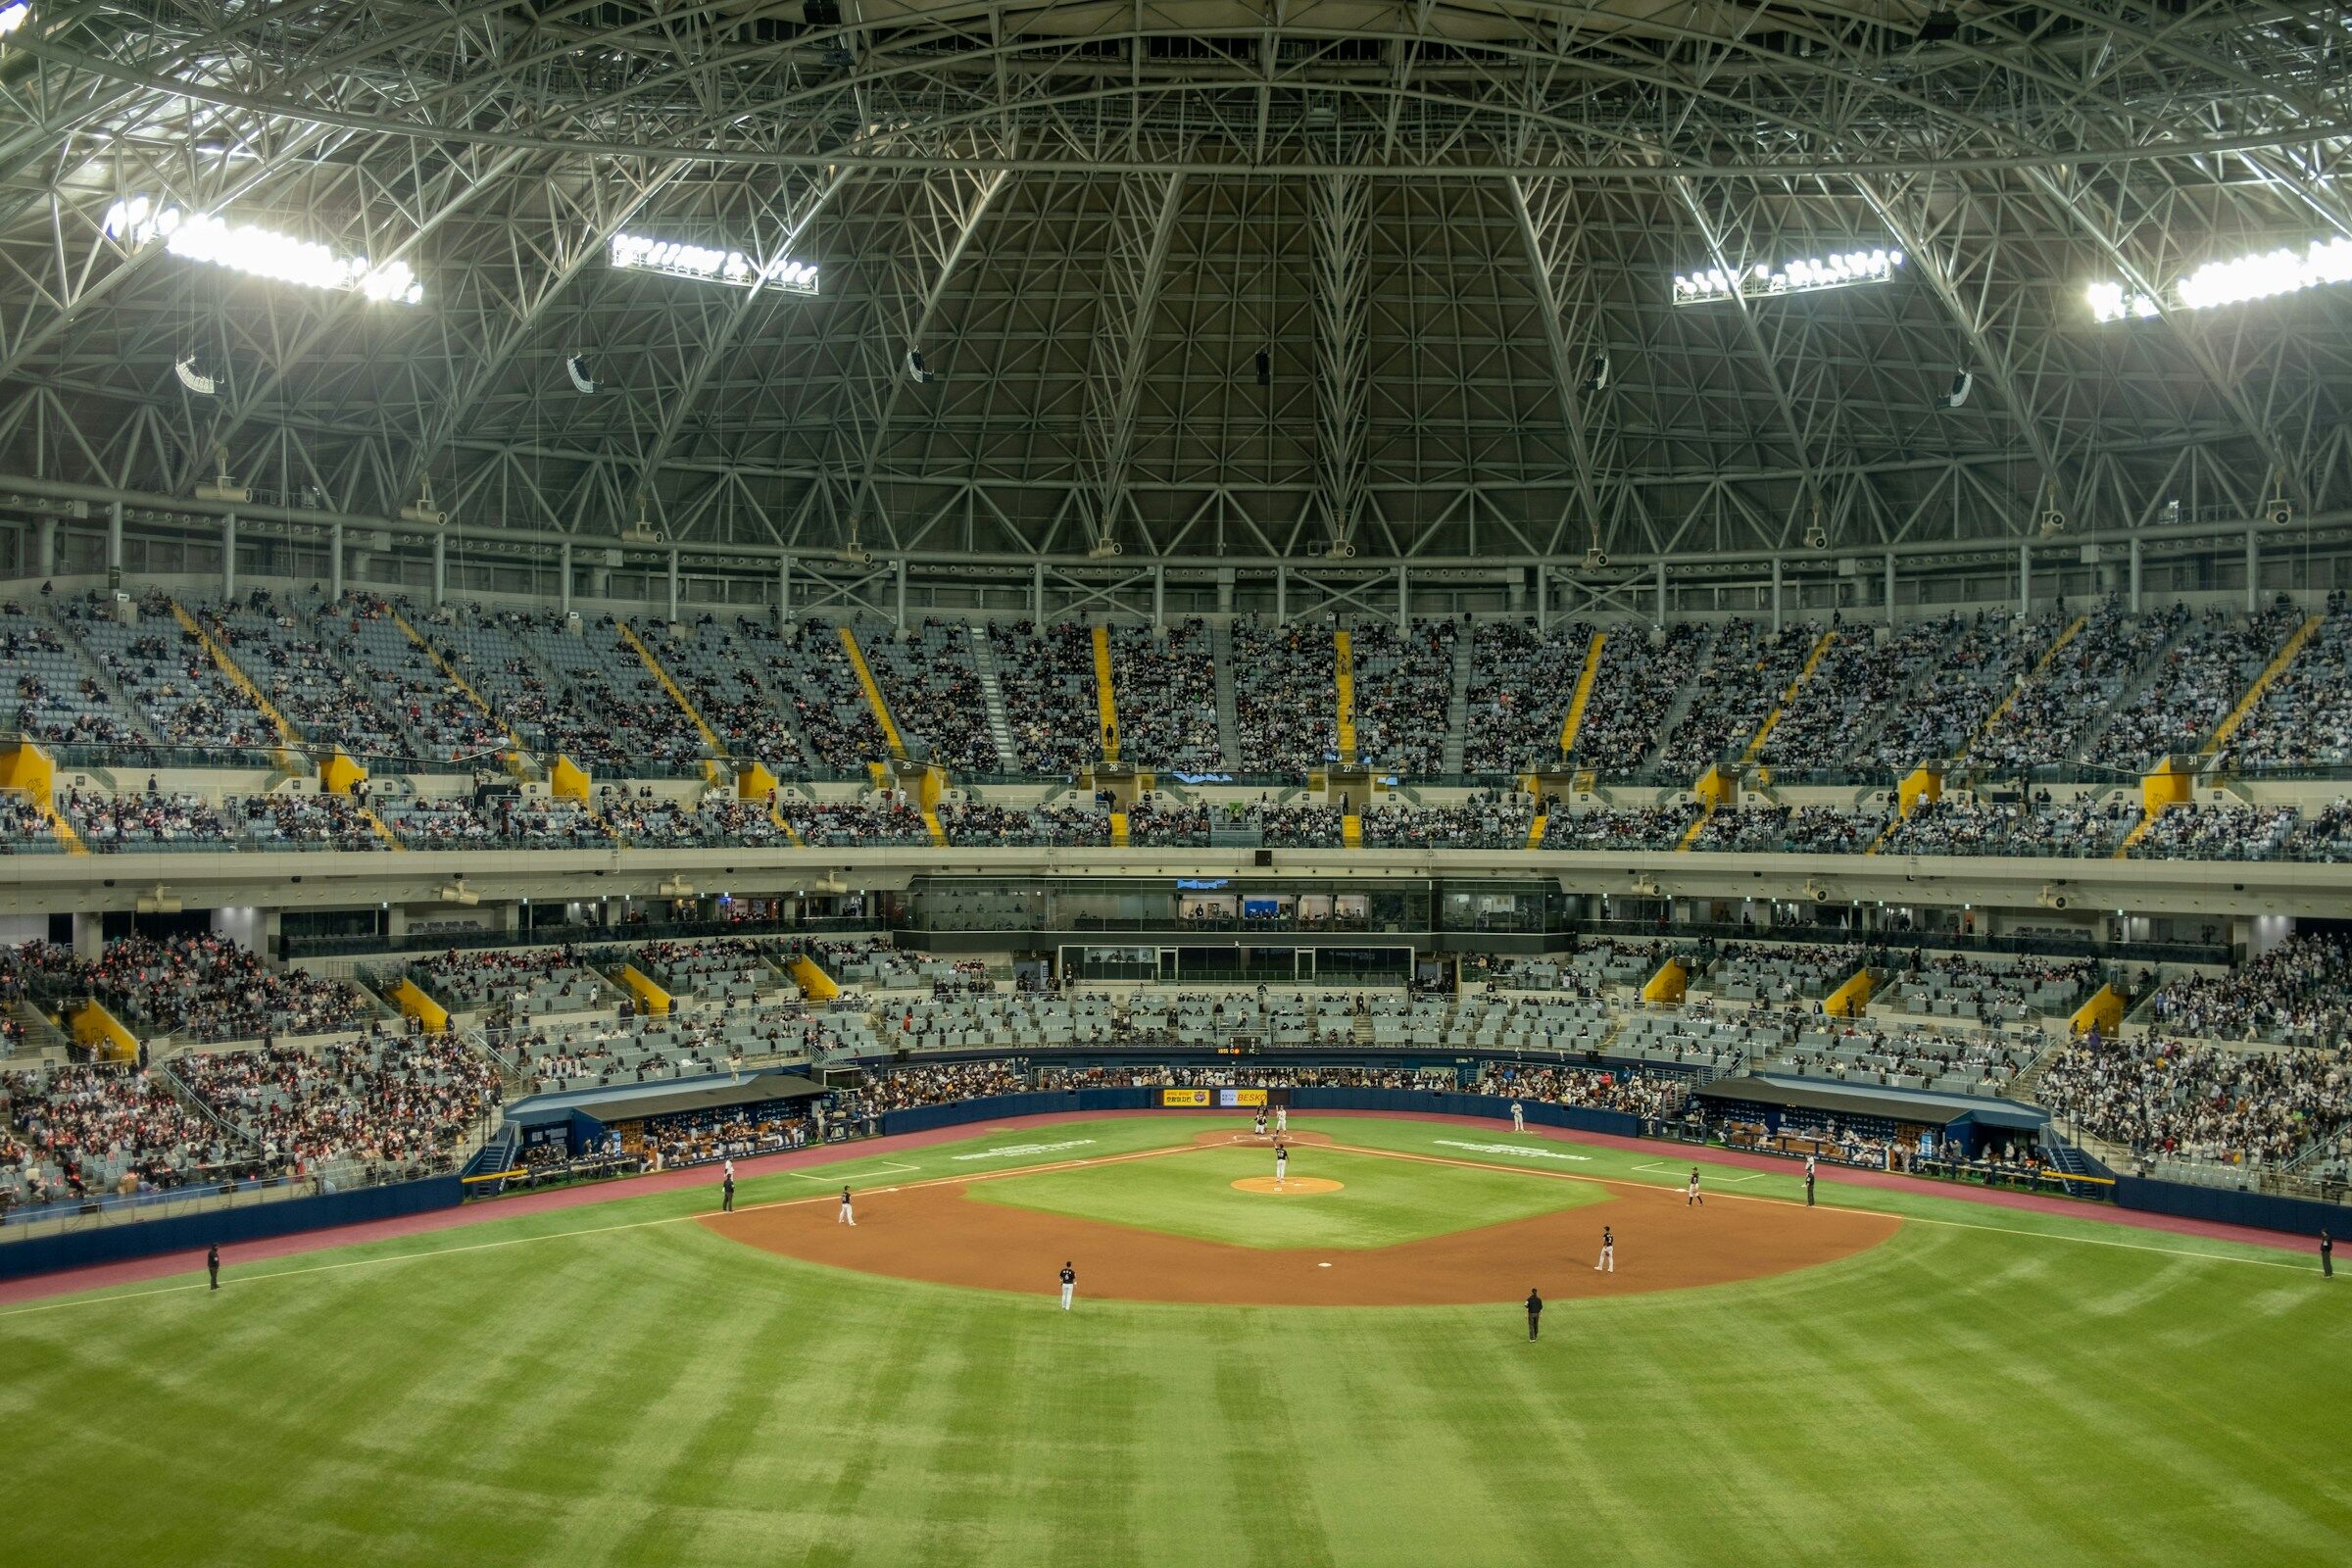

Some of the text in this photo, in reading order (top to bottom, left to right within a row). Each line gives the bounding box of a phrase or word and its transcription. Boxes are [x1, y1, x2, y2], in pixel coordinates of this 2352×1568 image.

[308, 745, 318, 755] 22
[537, 753, 545, 761] 23
[2188, 756, 2198, 765] 31
[903, 761, 912, 770] 25
[1109, 763, 1118, 772] 26
[1941, 760, 1951, 769] 30
[781, 956, 786, 964] 5
[1691, 957, 1697, 967] 8
[1883, 970, 1888, 978] 9
[378, 980, 384, 989] 3
[2130, 985, 2139, 994] 10
[57, 1000, 64, 1011] 2
